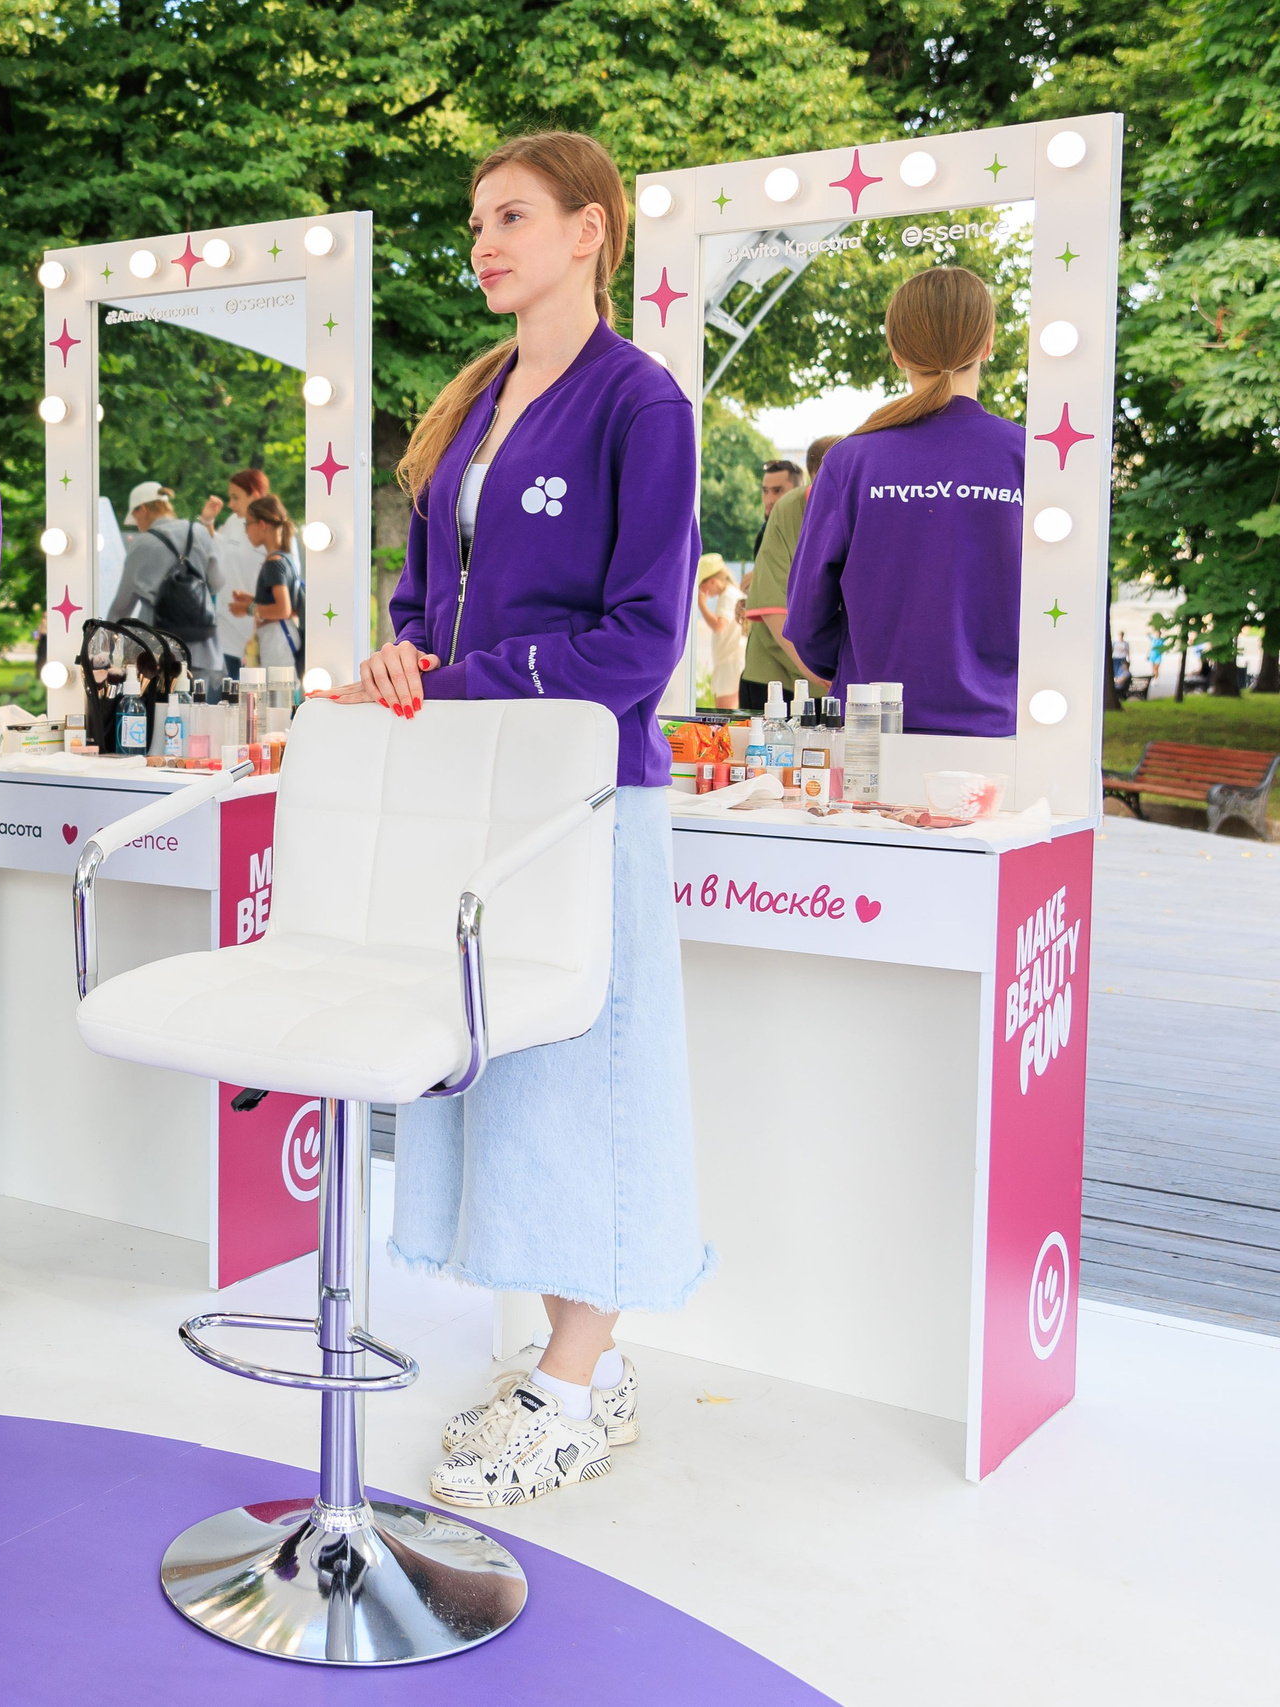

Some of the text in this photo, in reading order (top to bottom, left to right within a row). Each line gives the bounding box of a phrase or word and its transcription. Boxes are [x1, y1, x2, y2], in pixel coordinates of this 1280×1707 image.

[740, 242, 780, 259] Avito
[785, 236, 861, 257] Красота
[902, 220, 1009, 247] essence
[117, 309, 146, 323] Avito
[148, 304, 199, 322] Красота
[225, 293, 295, 314] essence
[700, 873, 719, 907] в
[725, 879, 845, 920] Москве
[1016, 885, 1066, 975] MAKE
[1005, 918, 1080, 1042] BEAUTY
[1020, 981, 1072, 1096] FUN
